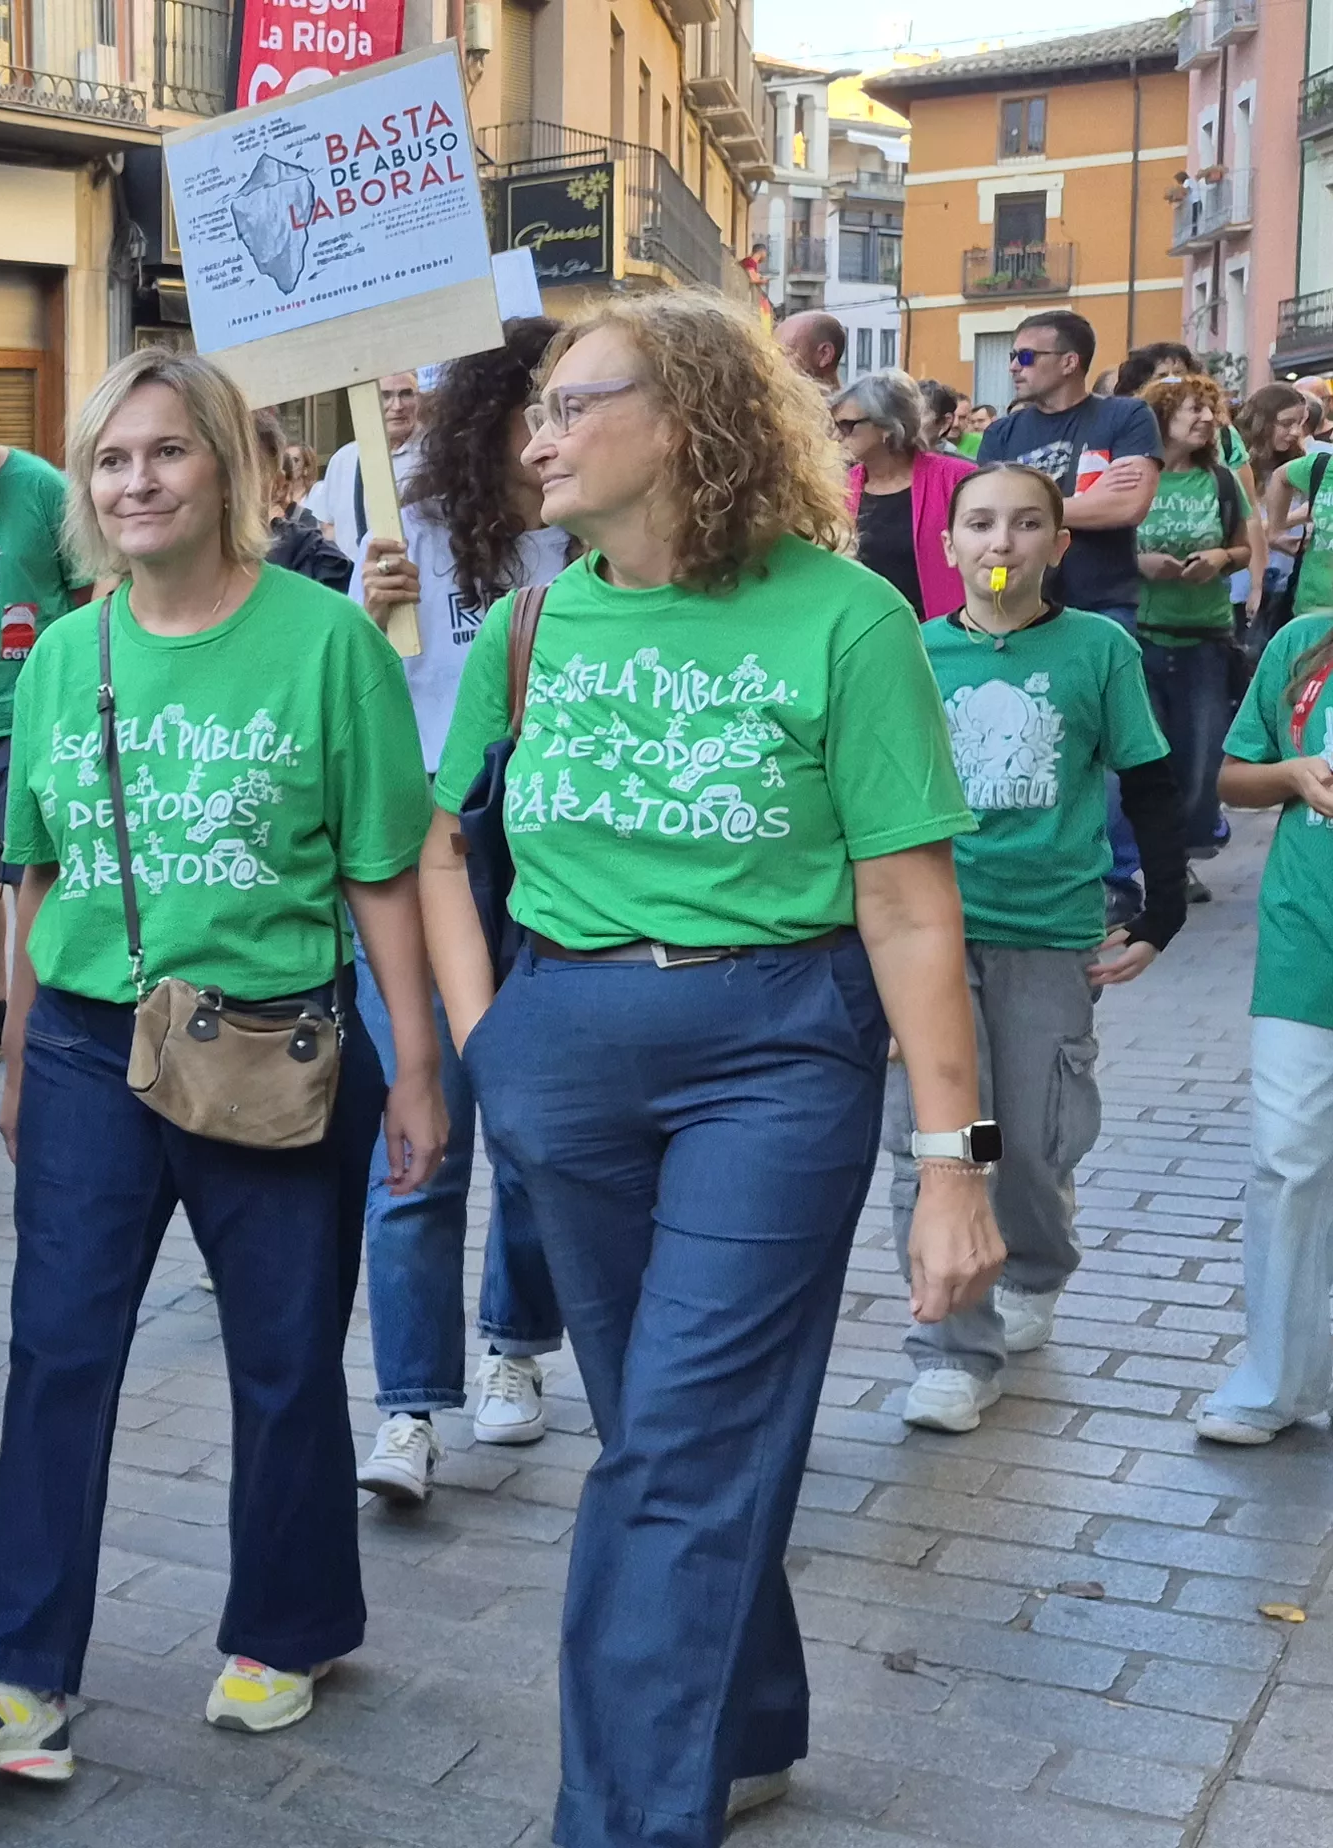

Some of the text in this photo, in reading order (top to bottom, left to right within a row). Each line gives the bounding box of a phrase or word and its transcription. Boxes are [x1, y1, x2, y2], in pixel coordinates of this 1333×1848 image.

[259, 16, 372, 61] La Rioja
[324, 99, 454, 166] BASTA
[330, 131, 458, 187] DE ABUSO
[288, 154, 465, 232] LABORAL
[274, 298, 307, 314] huelga
[309, 283, 359, 304] educativa
[362, 277, 378, 289] del
[394, 270, 408, 279] de
[410, 254, 454, 275] octubre!
[2, 647, 31, 660] CGT
[526, 658, 799, 714] ESCUELA PÚBLICA:
[178, 713, 303, 768] PÚBLICA:
[542, 734, 762, 774] DE TOD@S
[68, 790, 260, 831] DE TOD@S
[508, 791, 791, 844] PARA TOD@S
[965, 777, 1059, 810] PARQUE
[158, 852, 281, 892] TOD@S
